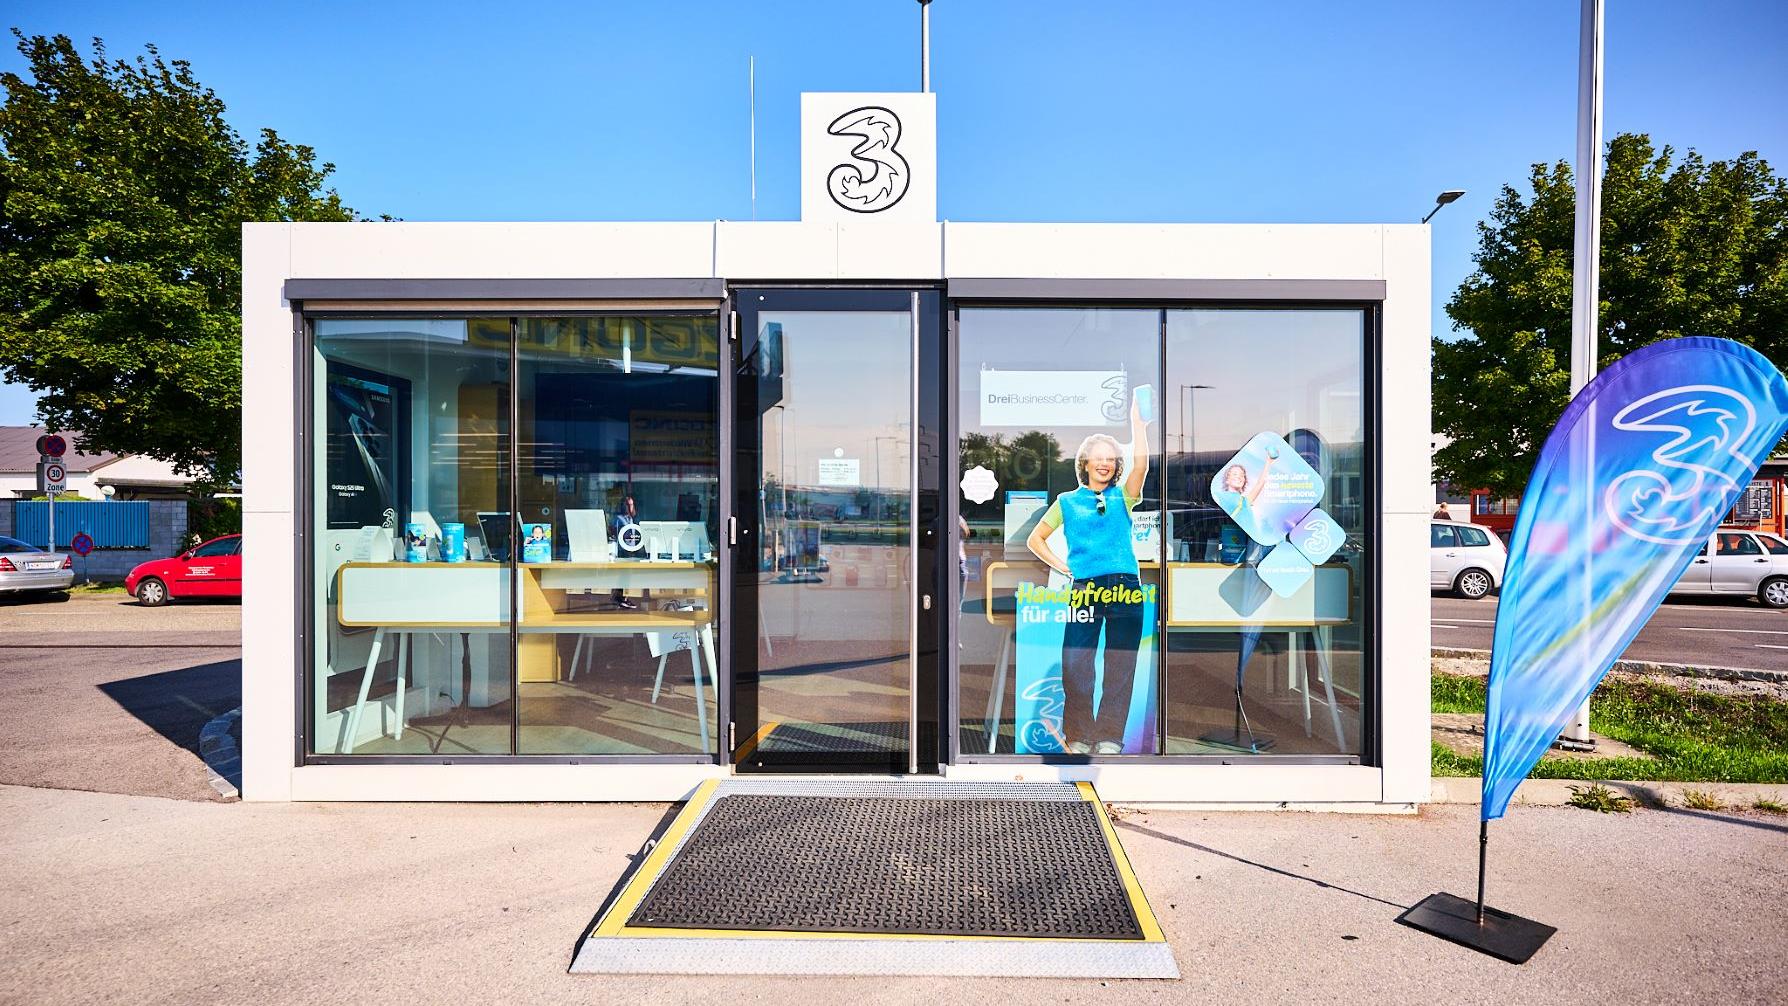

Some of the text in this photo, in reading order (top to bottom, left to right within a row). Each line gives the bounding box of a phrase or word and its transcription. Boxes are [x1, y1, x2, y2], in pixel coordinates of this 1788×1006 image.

[1016, 582, 1156, 608] Handyfreiheit
[1022, 605, 1095, 623] für alle!
